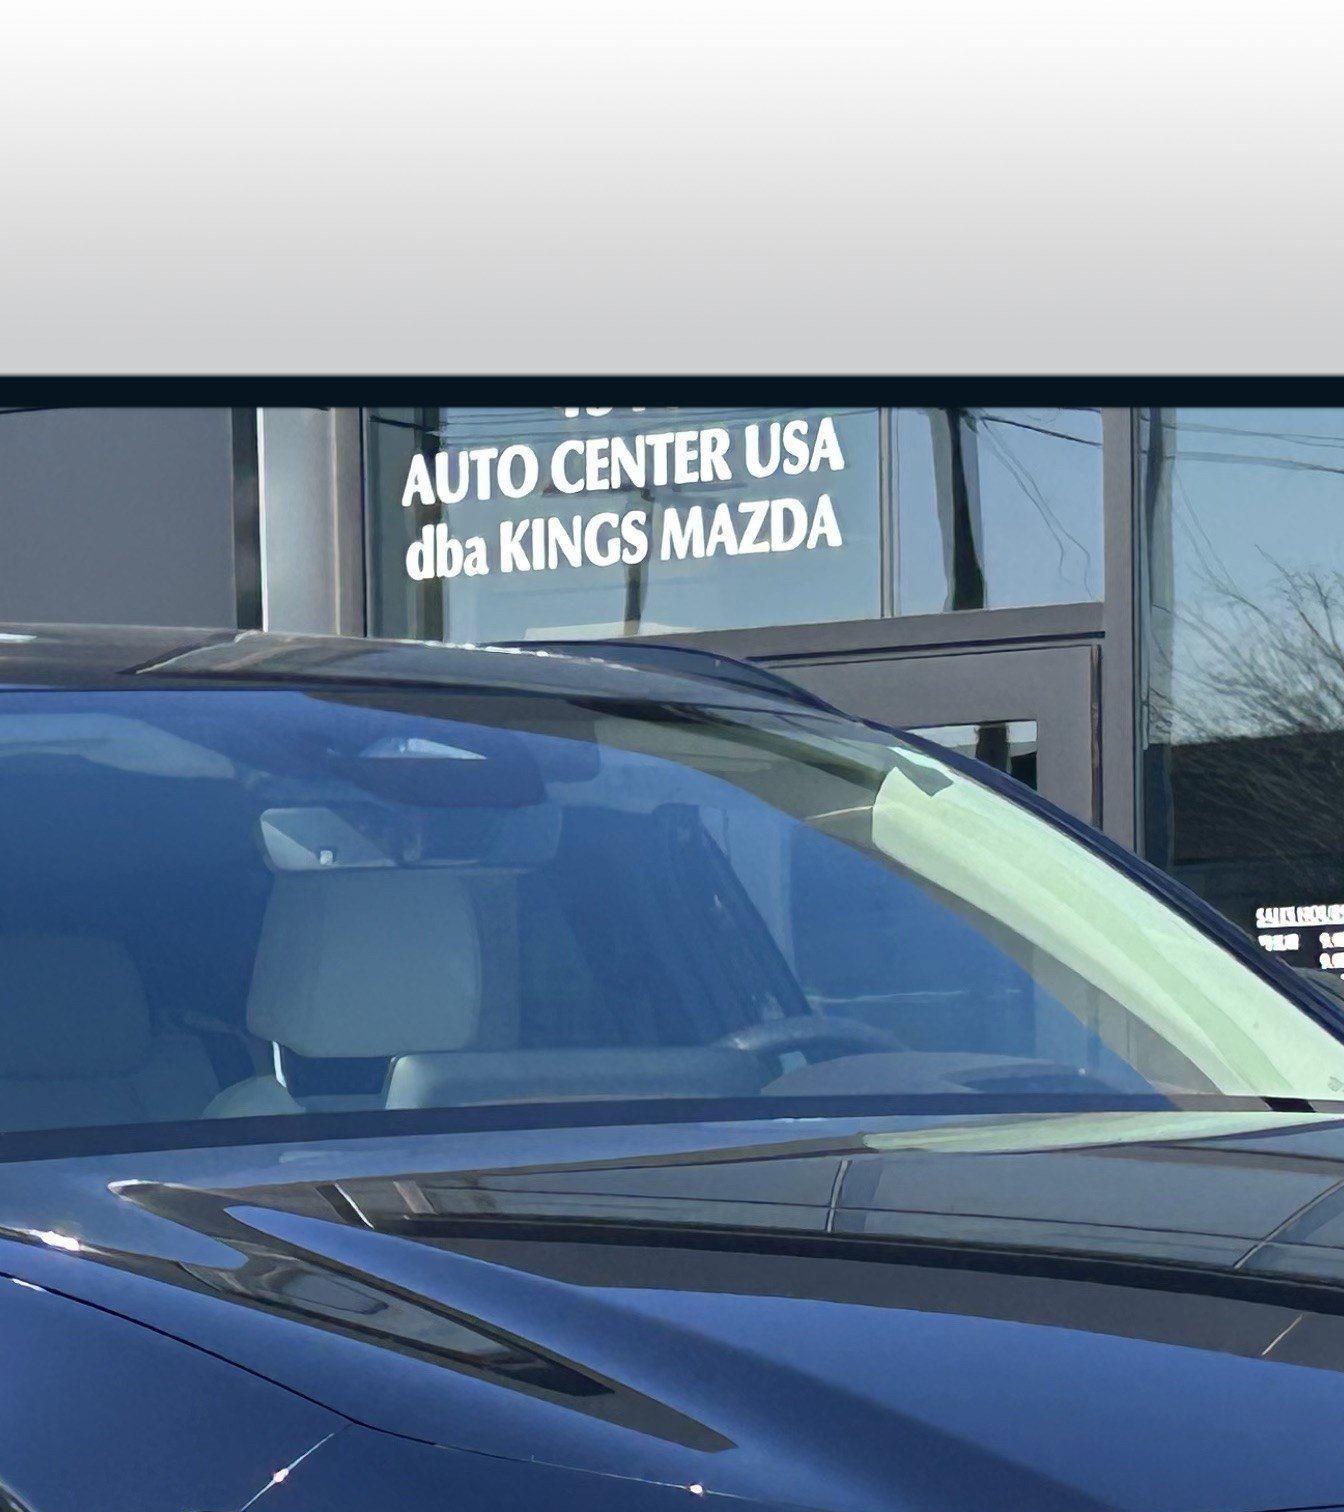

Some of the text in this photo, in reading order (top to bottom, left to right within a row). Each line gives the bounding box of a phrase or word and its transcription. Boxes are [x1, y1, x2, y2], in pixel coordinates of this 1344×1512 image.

[401, 417, 845, 508] AUTO CENTER USA
[405, 493, 844, 582] dba KINGS MAZDA
